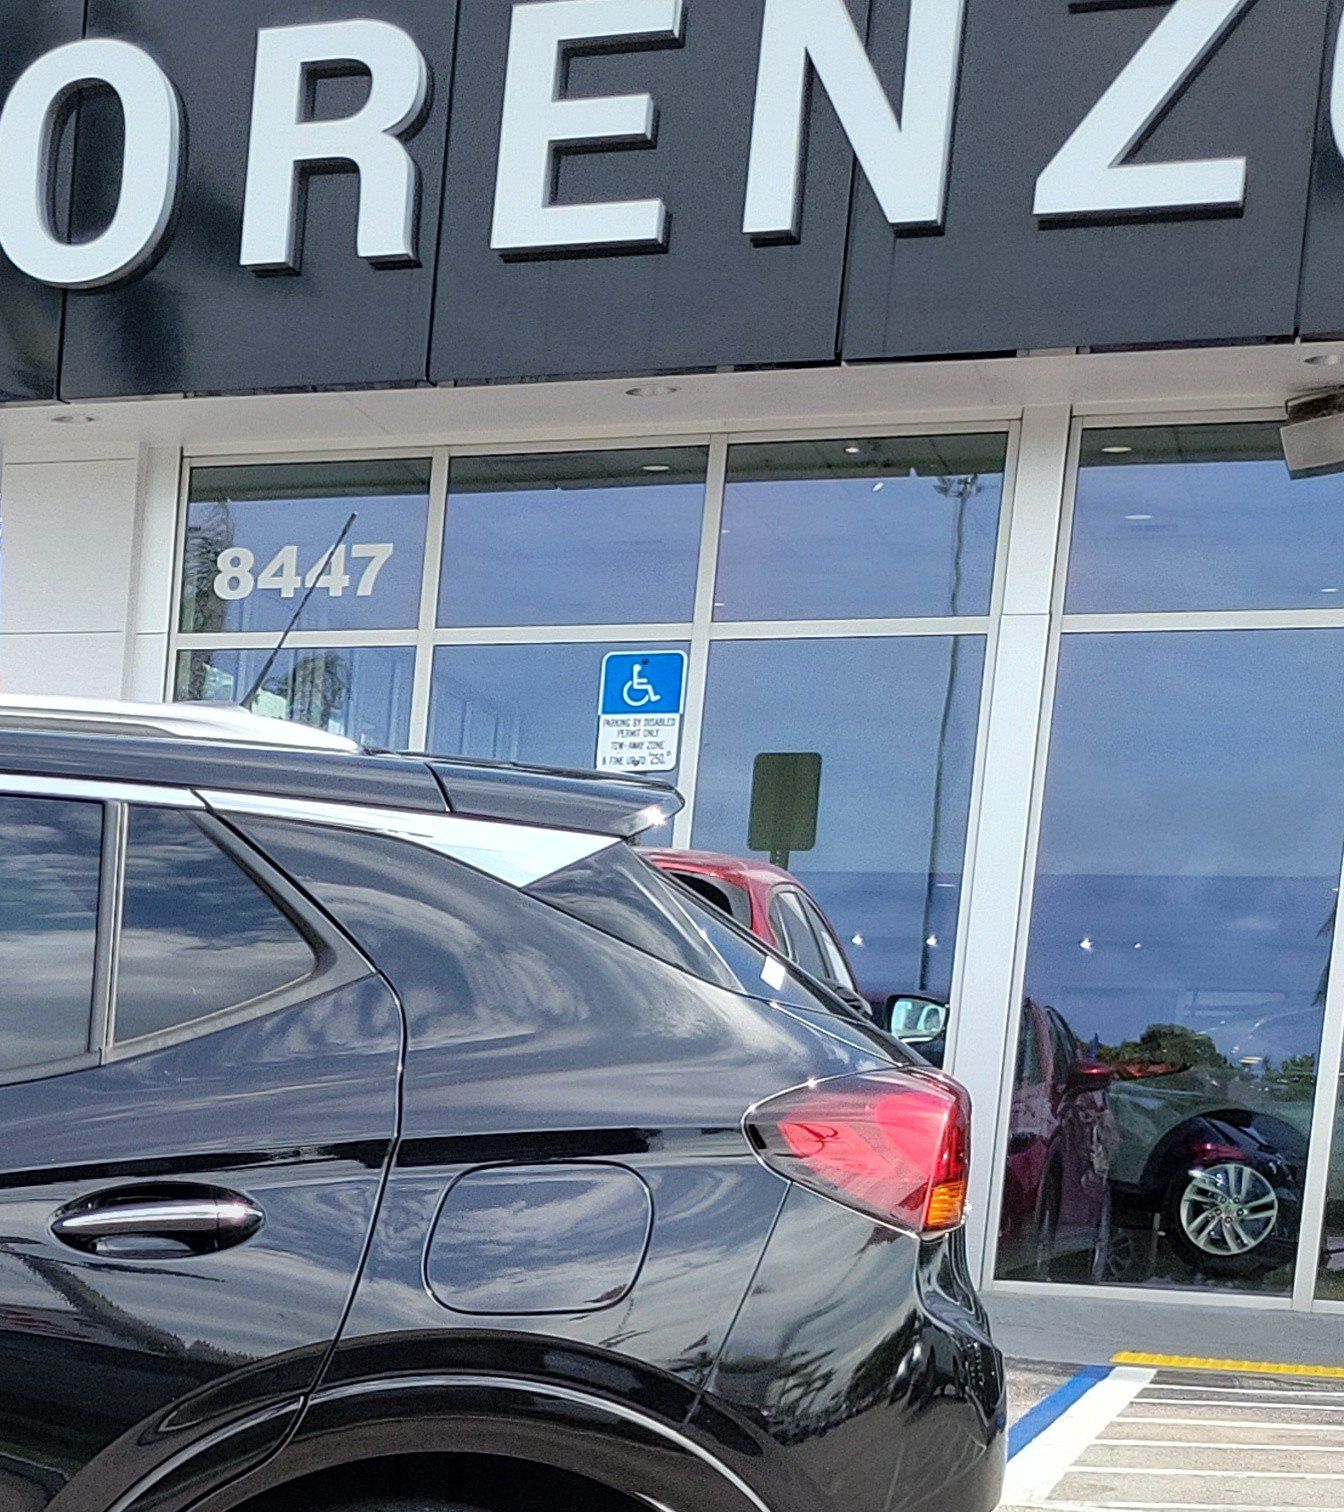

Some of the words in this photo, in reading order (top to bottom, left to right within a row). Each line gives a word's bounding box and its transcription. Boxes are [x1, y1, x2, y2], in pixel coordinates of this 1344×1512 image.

[213, 543, 394, 600] 8447
[643, 717, 676, 727] DISABLED
[643, 728, 660, 738] ONLY
[647, 740, 665, 750] ZONE
